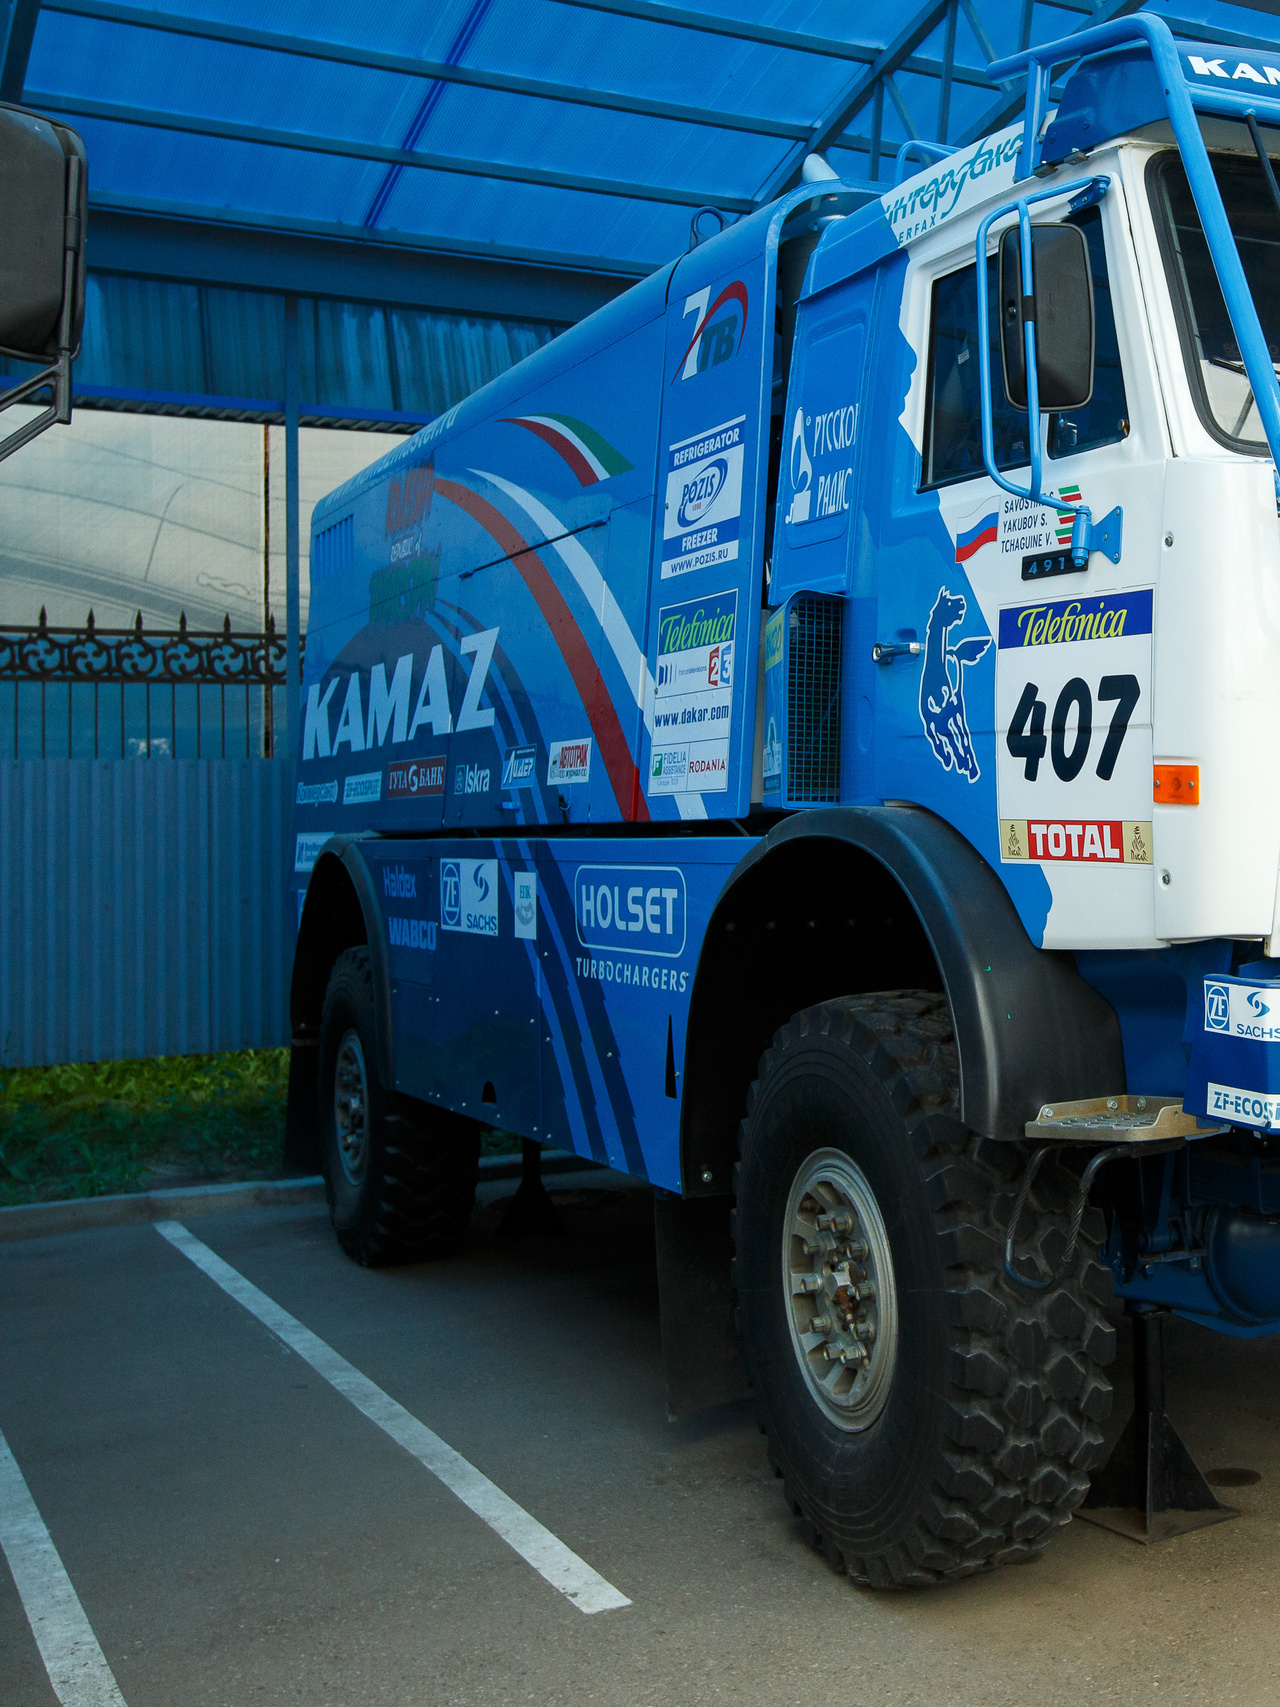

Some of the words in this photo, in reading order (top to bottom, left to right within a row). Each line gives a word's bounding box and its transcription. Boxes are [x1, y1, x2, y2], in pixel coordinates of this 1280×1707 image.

[674, 428, 739, 467] REFRIGERATOR
[681, 473, 716, 505] POZIS
[1003, 514, 1038, 533] YAKUBOV
[1040, 513, 1048, 526] S.
[682, 528, 718, 552] FREEZER
[1002, 533, 1042, 553] TCHAGUINE
[1045, 532, 1053, 546] V.
[671, 548, 728, 574] WWW.POZIS.RU
[302, 627, 500, 760] KAMAZ
[654, 705, 729, 727] www.dakar.com
[1006, 674, 1141, 783] 407
[663, 751, 686, 765] FIDELIA
[689, 759, 726, 773] RODANIA
[388, 770, 408, 790] ГУТА
[419, 766, 444, 787] БАНК
[464, 764, 490, 794] Iskra
[1031, 824, 1120, 858] TOTAL
[383, 864, 417, 898] Haldex
[466, 913, 497, 932] SACHS
[582, 885, 678, 935] HOLSET
[388, 916, 436, 950] WABCO
[576, 957, 687, 993] TURBOCHARGERS
